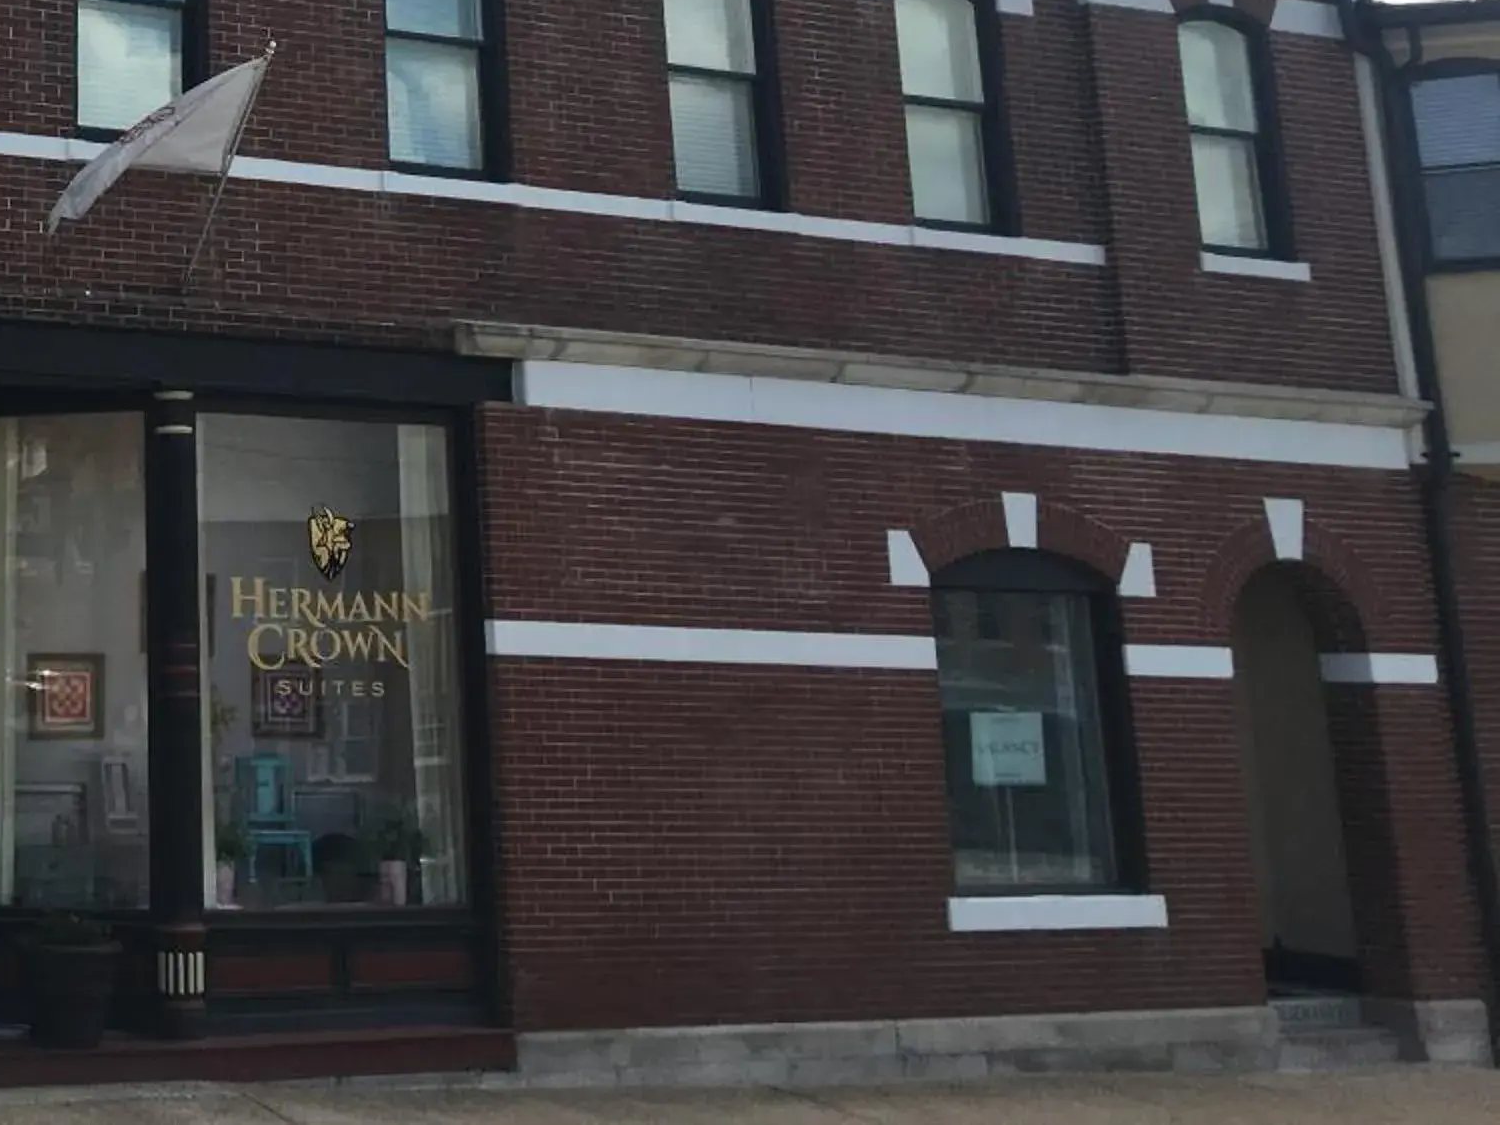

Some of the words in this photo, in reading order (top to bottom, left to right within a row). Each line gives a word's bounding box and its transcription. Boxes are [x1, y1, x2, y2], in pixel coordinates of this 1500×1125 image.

[230, 577, 428, 627] HERMANN
[247, 624, 412, 670] CROWN
[275, 679, 385, 697] SUITES
